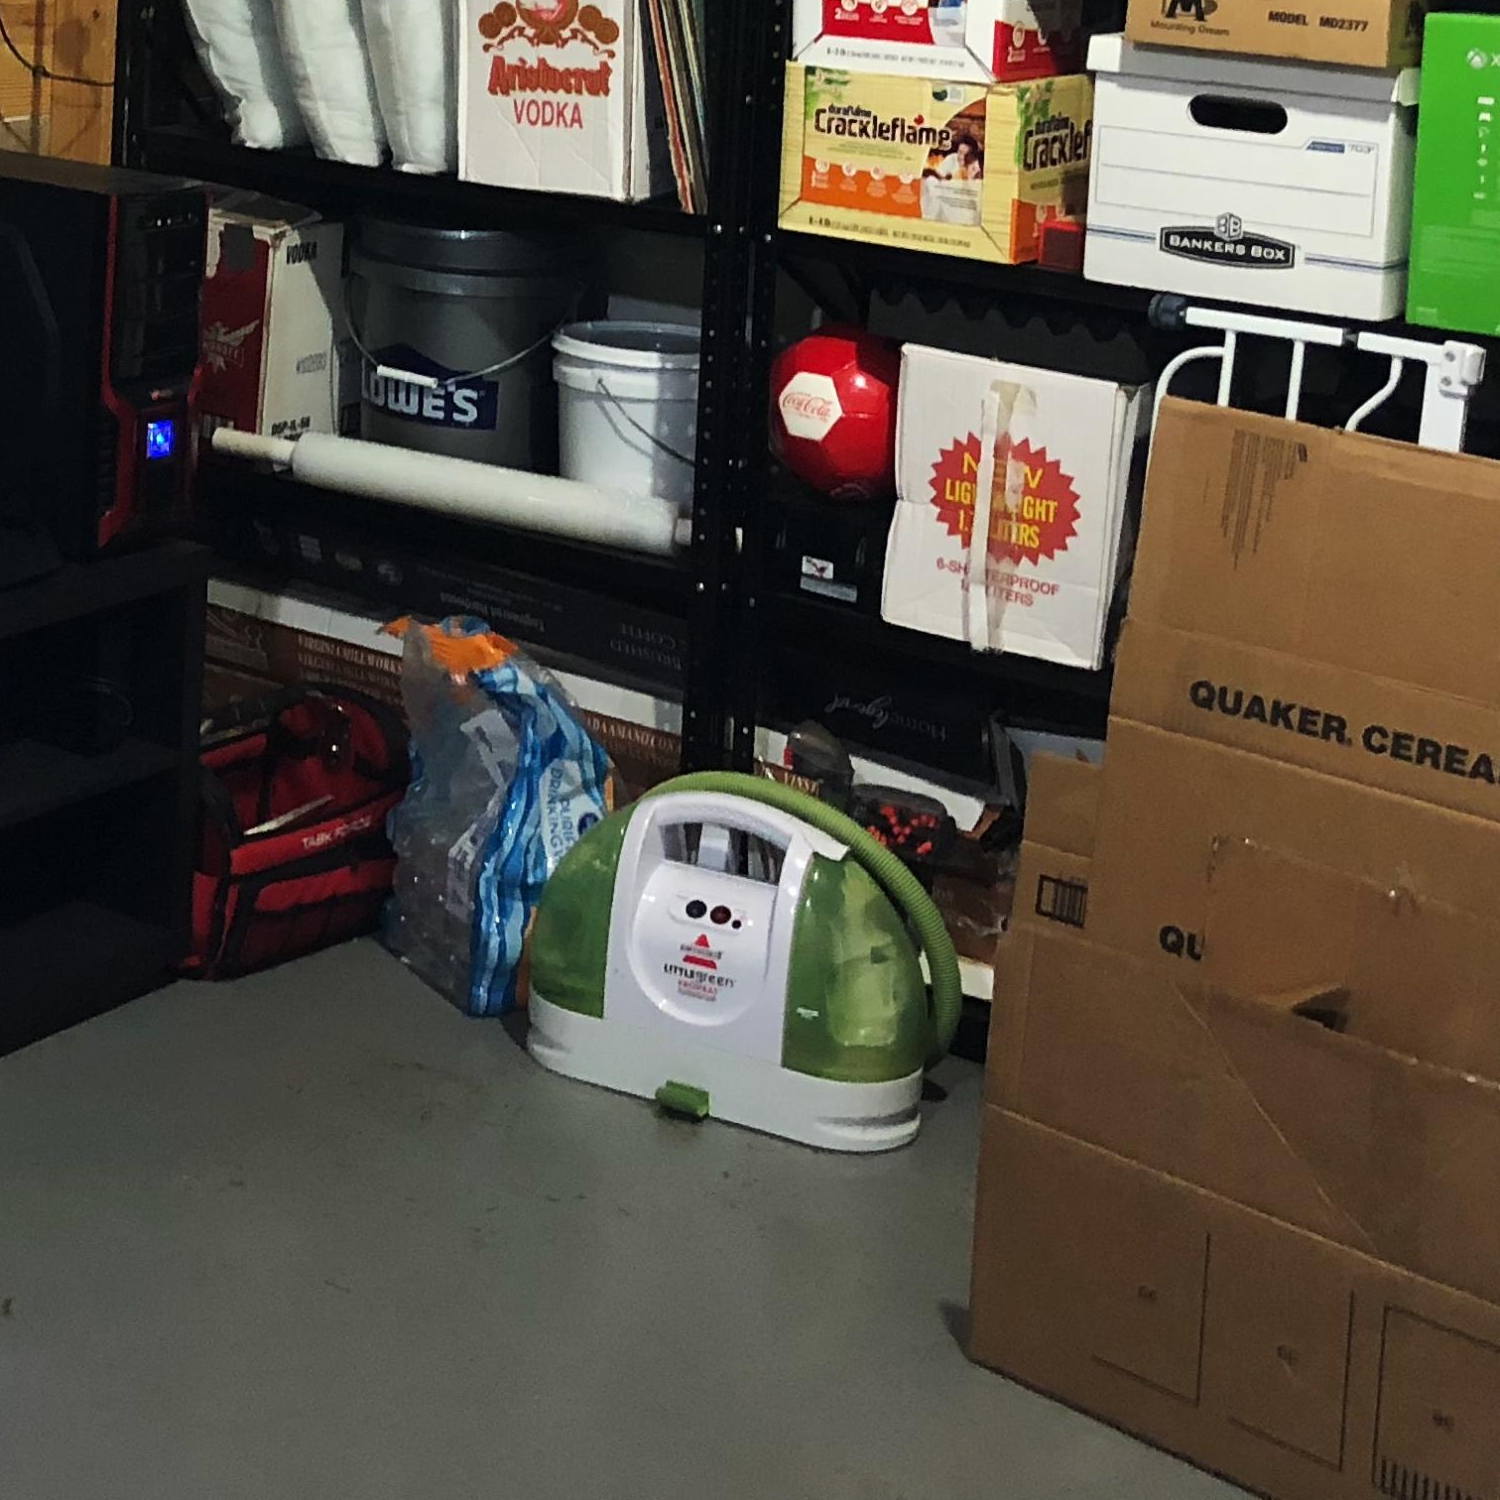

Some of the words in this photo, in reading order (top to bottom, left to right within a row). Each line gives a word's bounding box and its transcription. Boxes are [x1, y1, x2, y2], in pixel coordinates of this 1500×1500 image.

[1150, 19, 1196, 36] Mounting
[1267, 10, 1309, 27] MODEL
[1318, 15, 1369, 32] MD2377
[487, 54, 613, 98] Aristocrat
[512, 98, 584, 130] VODKA
[814, 107, 952, 149] Crackleflame
[1022, 119, 1094, 172] Cracklef
[285, 241, 318, 265] VODKA
[1168, 234, 1247, 256] BANKERS
[1250, 245, 1287, 261] BOX
[1189, 679, 1348, 744] QUAKER
[1361, 724, 1500, 785] CEREA
[548, 766, 564, 852] DRINKING
